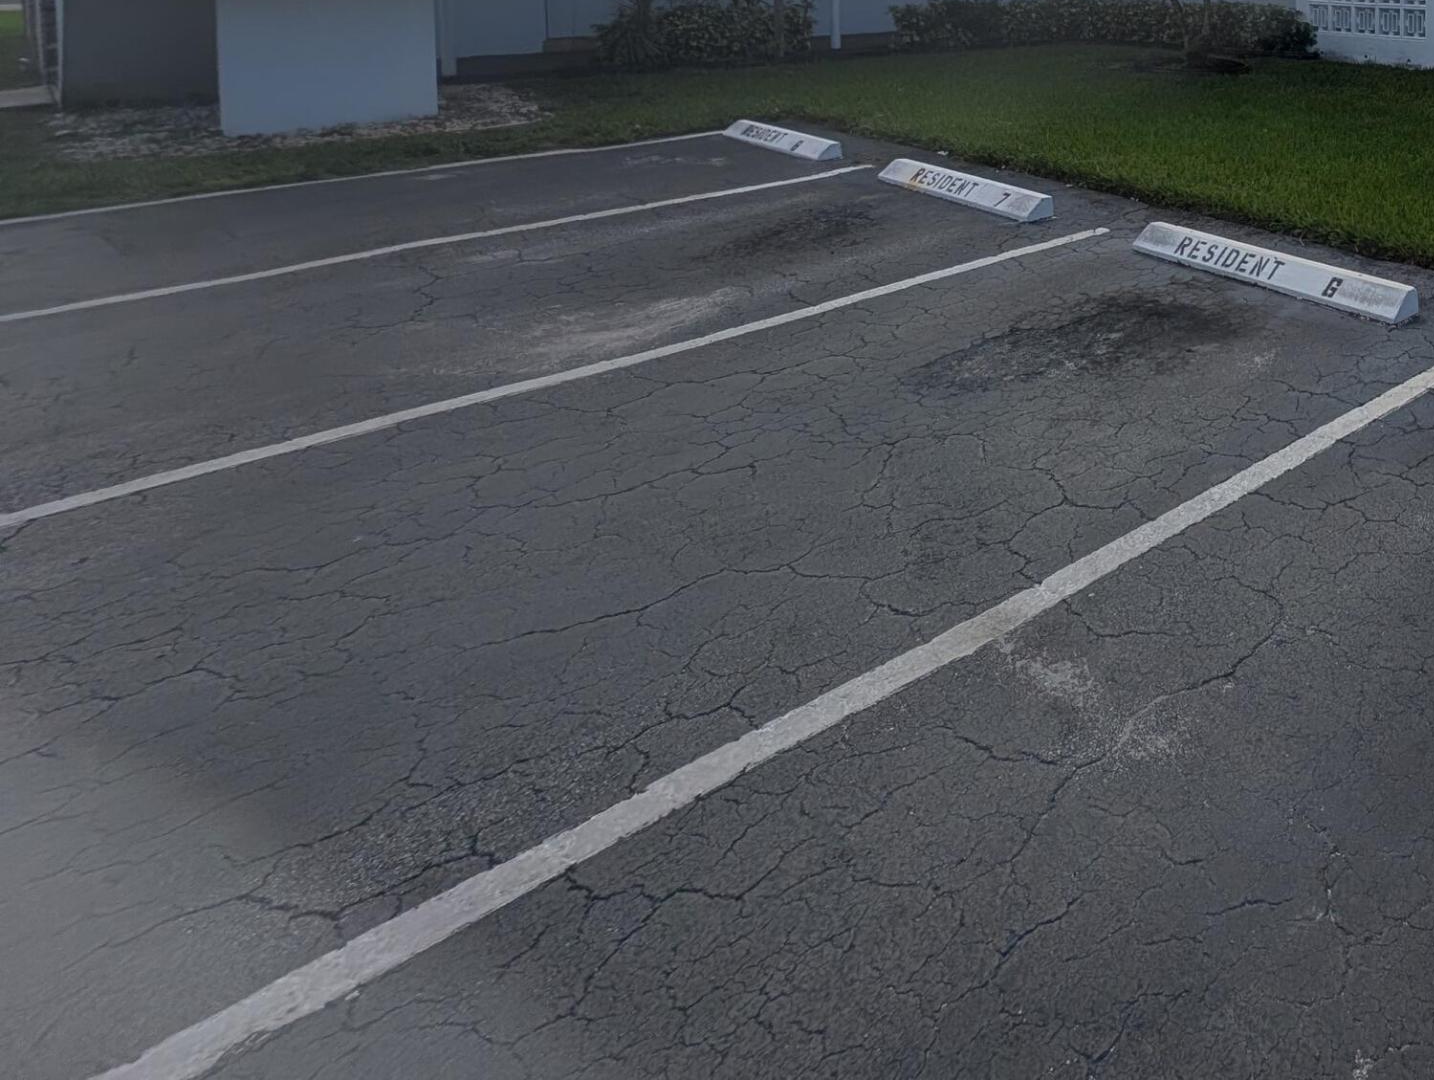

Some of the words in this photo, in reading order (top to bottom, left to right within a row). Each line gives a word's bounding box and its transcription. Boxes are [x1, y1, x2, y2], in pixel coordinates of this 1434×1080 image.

[910, 168, 979, 197] RESIDENT
[994, 192, 1011, 207] 7
[1174, 236, 1285, 280] RESIDENT
